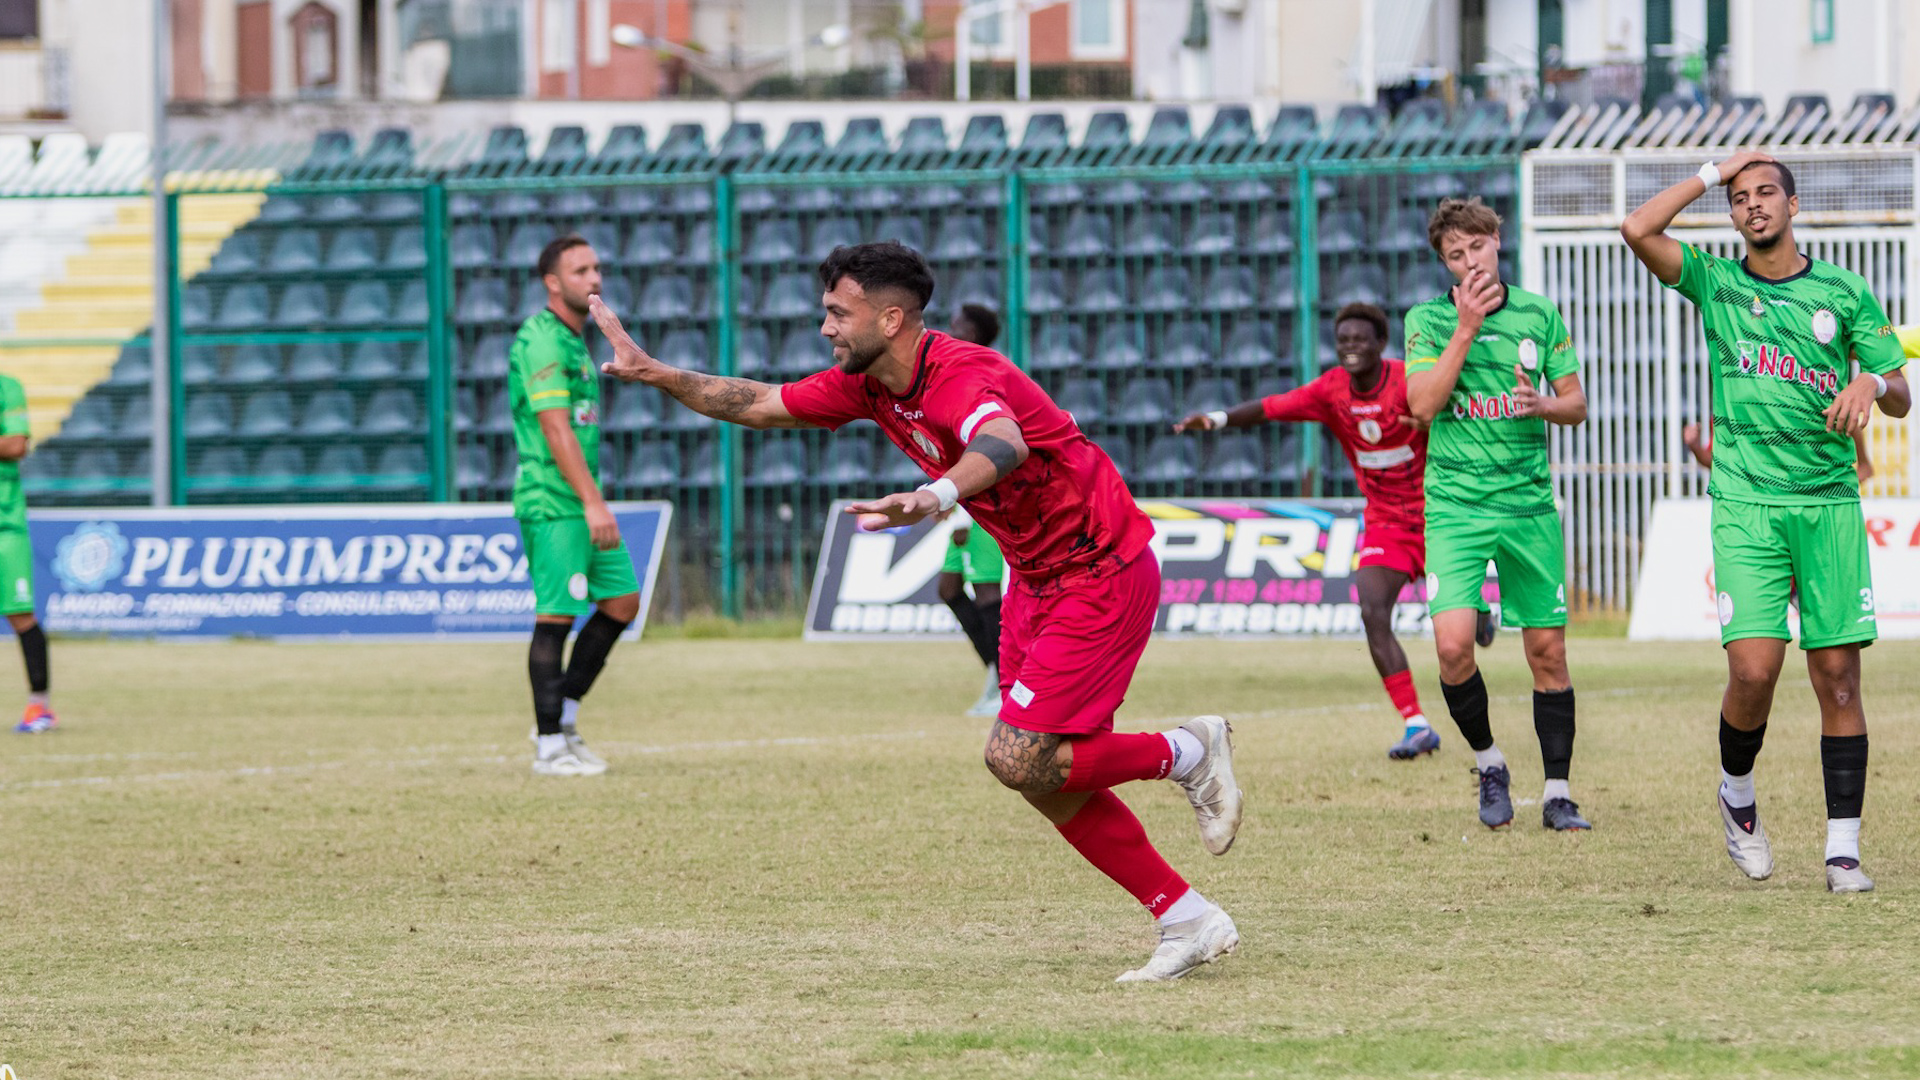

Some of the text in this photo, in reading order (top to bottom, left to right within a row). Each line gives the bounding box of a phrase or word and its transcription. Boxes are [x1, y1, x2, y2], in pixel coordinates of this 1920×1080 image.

[1149, 518, 1360, 578] PRI
[46, 591, 135, 618] LAVORO
[142, 591, 287, 618] FORMAZIONE
[295, 590, 441, 617] CONSULENZA
[1860, 587, 1873, 611] 3
